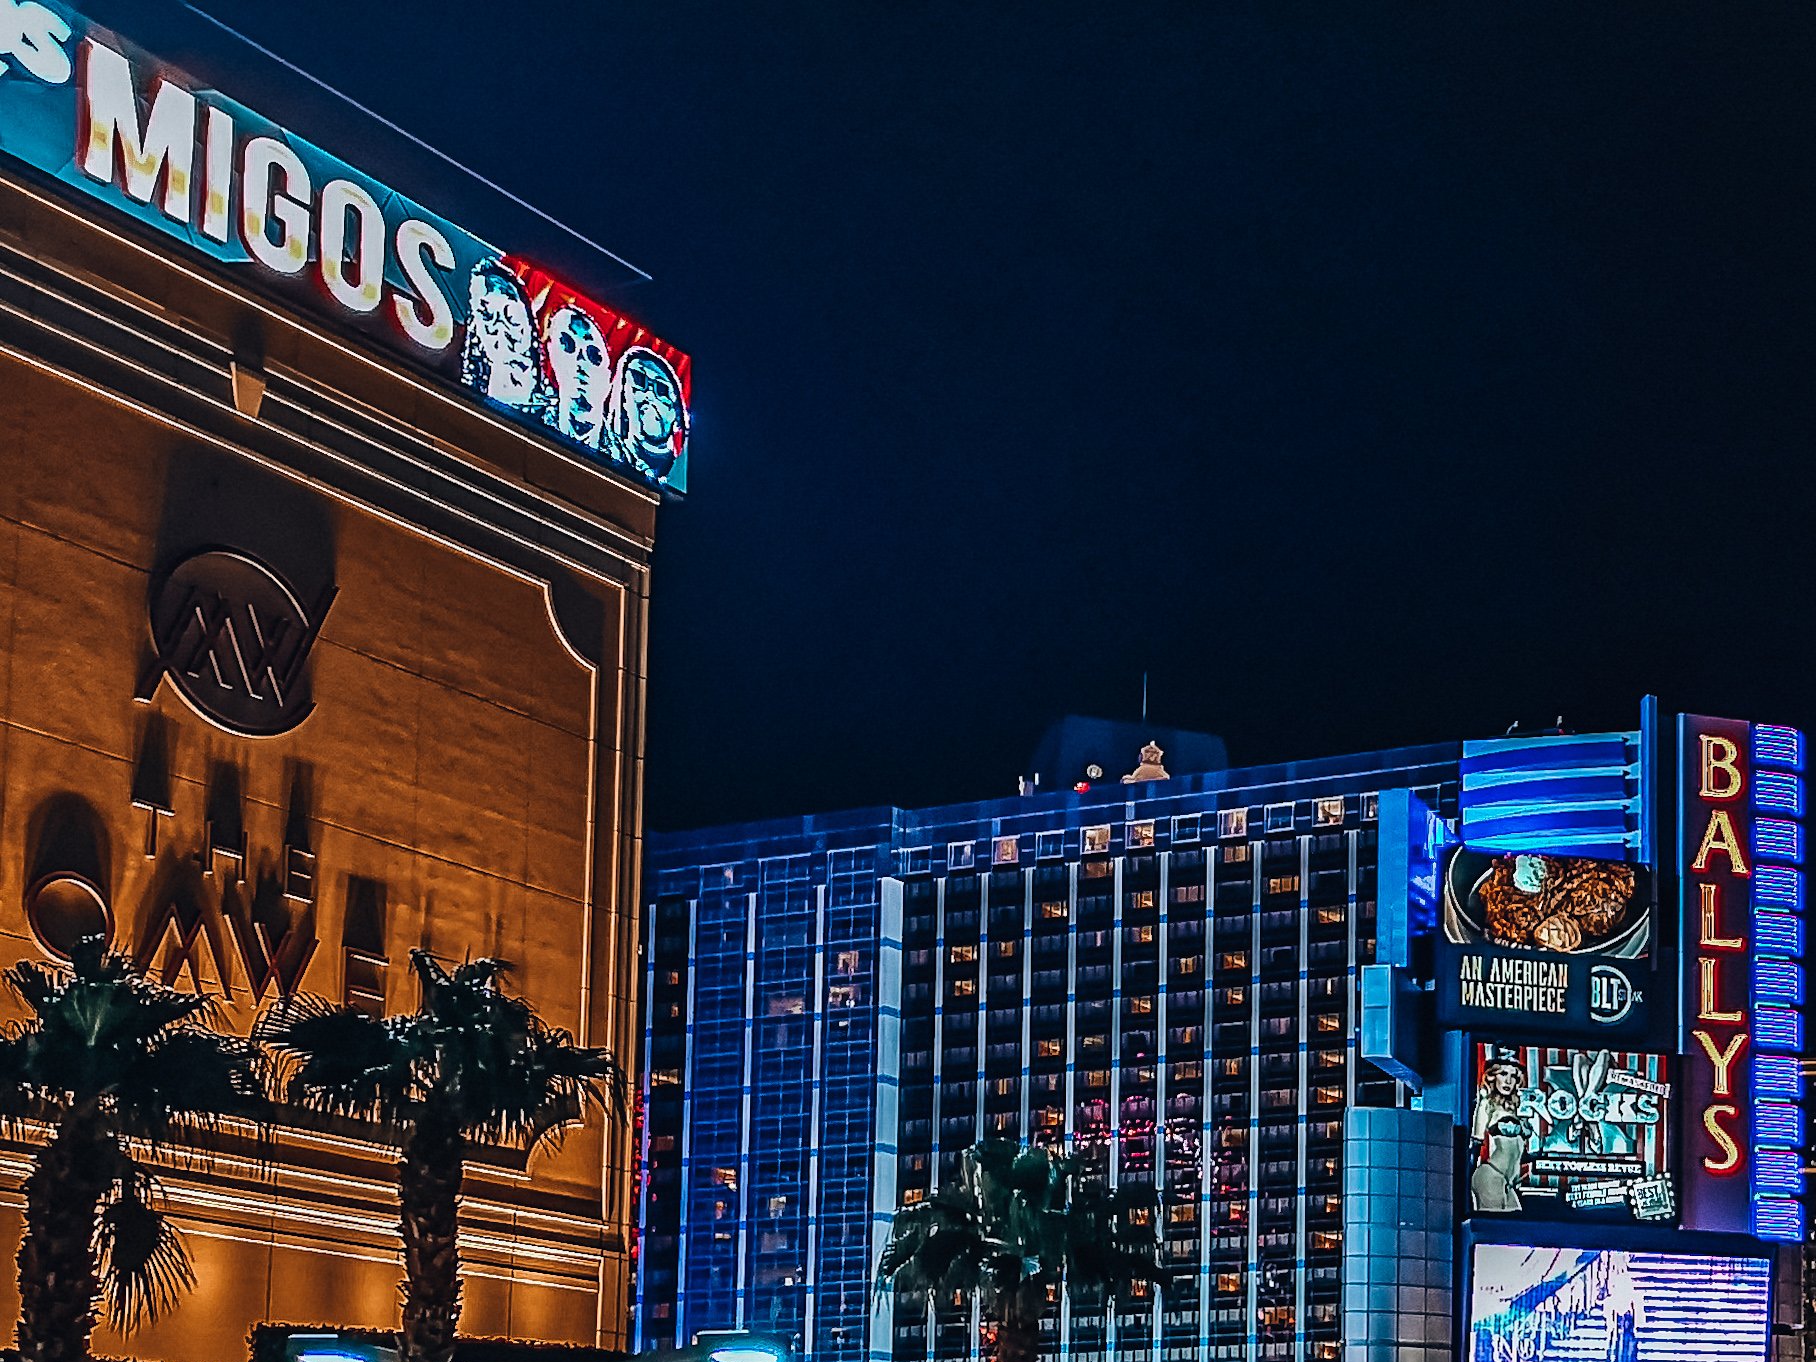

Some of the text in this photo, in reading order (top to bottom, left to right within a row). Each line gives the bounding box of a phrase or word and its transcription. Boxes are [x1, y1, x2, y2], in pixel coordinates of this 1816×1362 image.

[83, 36, 457, 351] MIGOS
[1692, 733, 1751, 1171] BALLYS
[1460, 955, 1569, 988] AN AMERICAN
[1460, 981, 1567, 1013] MASTERPIECE
[1590, 975, 1621, 1011] BLT
[1516, 1088, 1660, 1125] ROCKS
